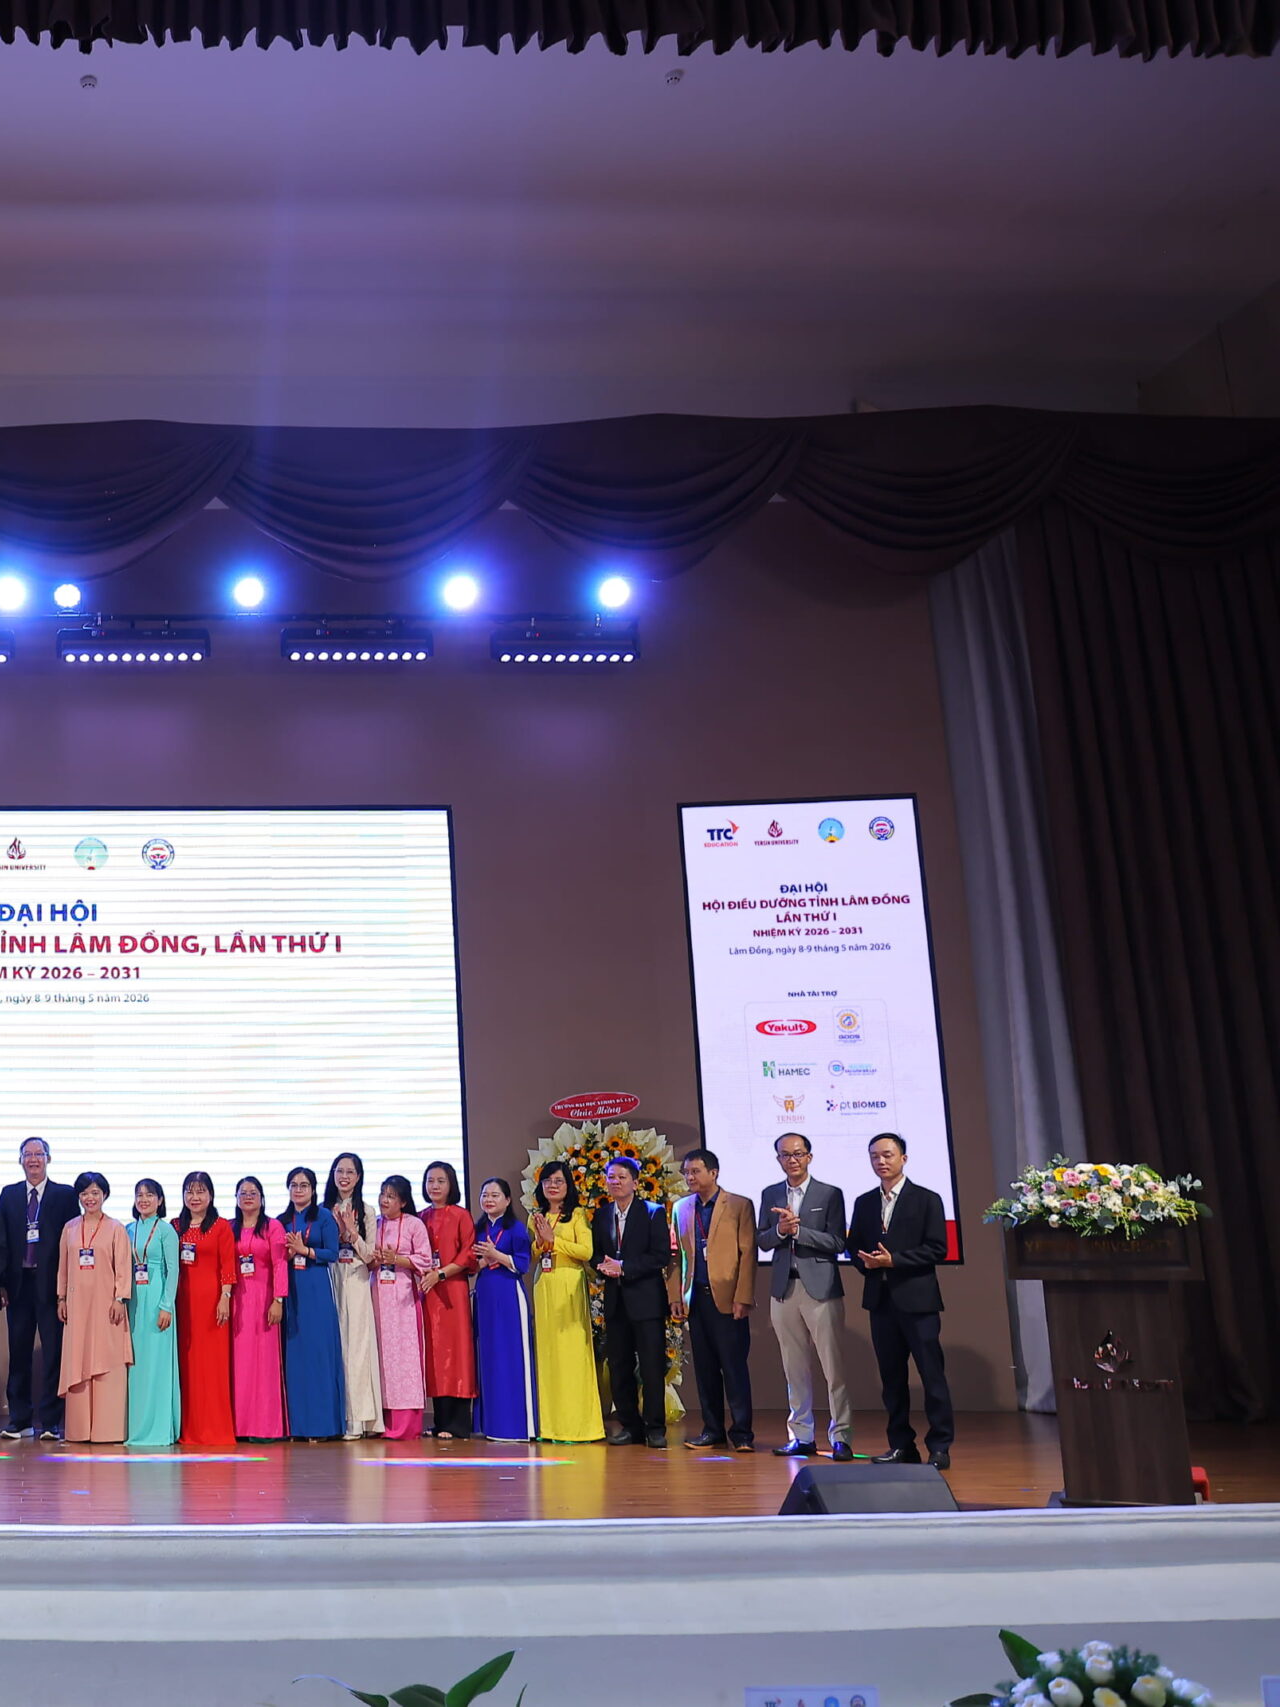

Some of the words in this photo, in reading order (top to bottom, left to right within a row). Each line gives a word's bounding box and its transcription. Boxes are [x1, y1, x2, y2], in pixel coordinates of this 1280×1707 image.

[707, 828, 733, 841] TTC
[780, 884, 802, 896] ĐẠI
[805, 881, 828, 894] HỘI
[50, 899, 97, 927] HỘI
[55, 931, 111, 954] LÂM
[118, 930, 207, 956] ĐỒNG,
[215, 930, 266, 954] LẦN
[272, 931, 330, 954] THỨ
[336, 935, 342, 953] I
[12, 964, 36, 980] KỲ
[40, 966, 83, 980] 2026
[100, 966, 141, 980] 2031
[5, 993, 32, 1005] ngày
[54, 993, 85, 1005] tháng
[88, 994, 94, 1003] 5
[97, 993, 121, 1003] năm
[123, 994, 150, 1003] 2026
[768, 1024, 805, 1032] Yakult
[778, 1067, 810, 1076] HAMEC
